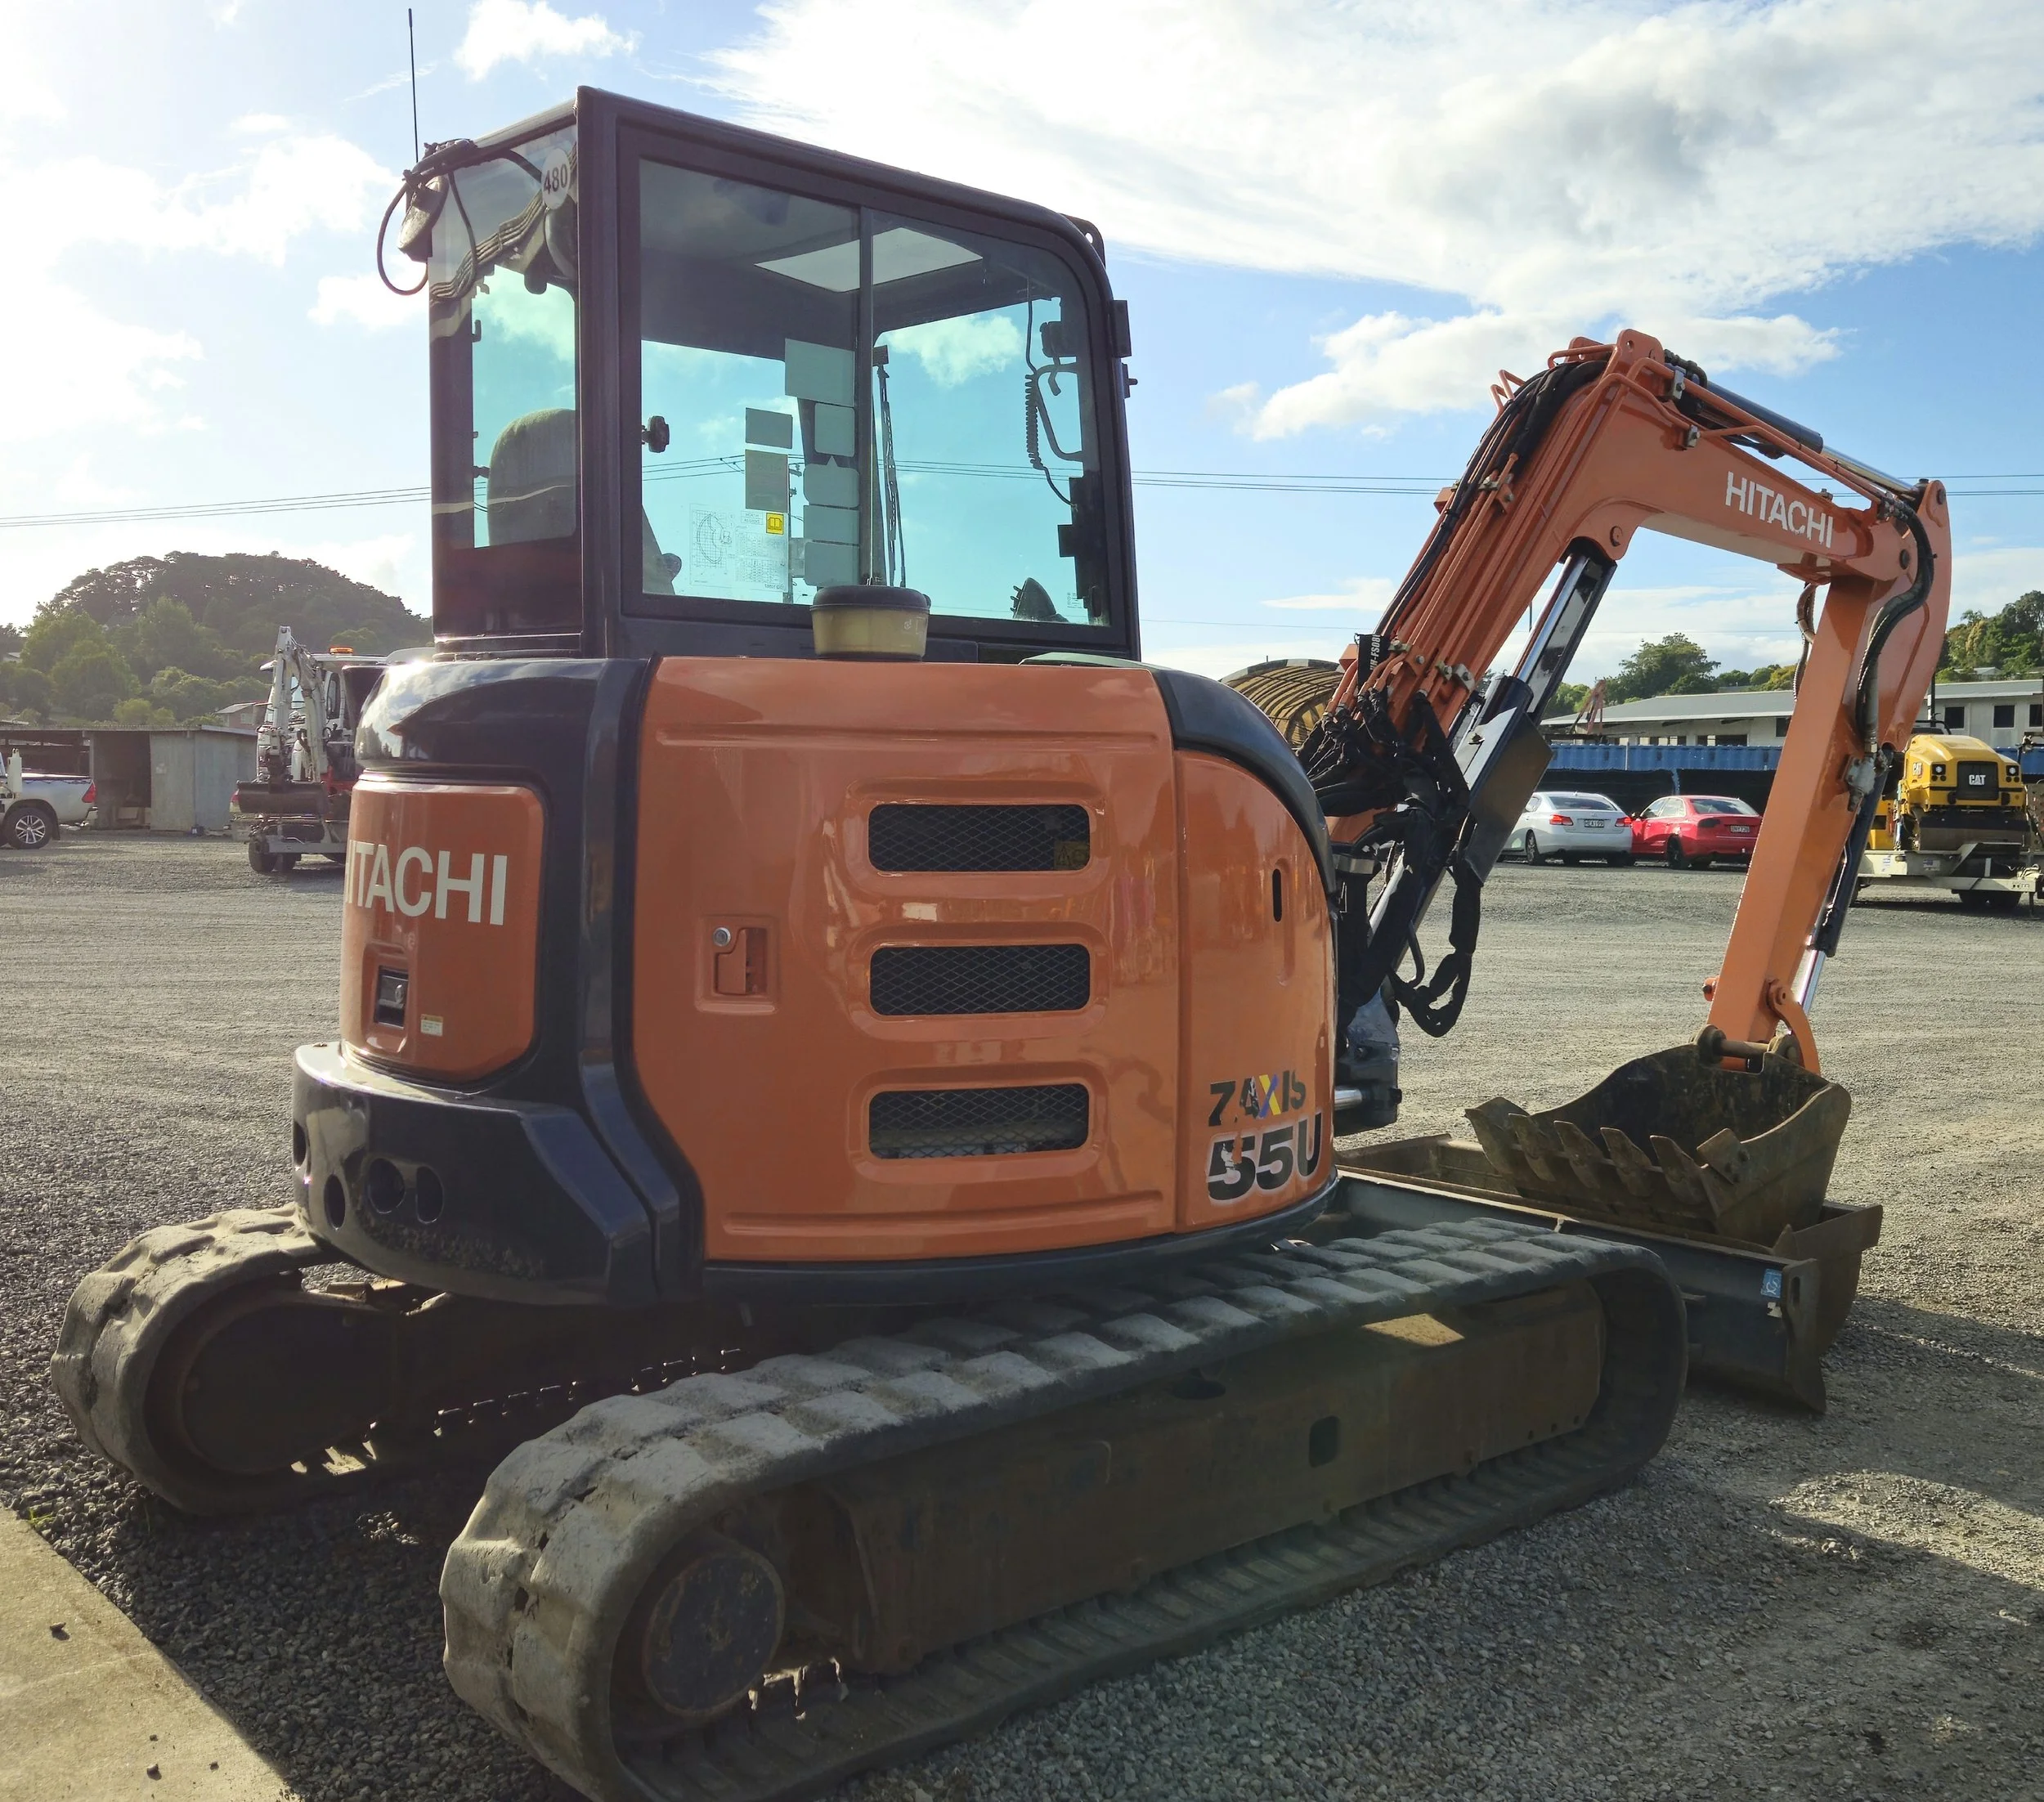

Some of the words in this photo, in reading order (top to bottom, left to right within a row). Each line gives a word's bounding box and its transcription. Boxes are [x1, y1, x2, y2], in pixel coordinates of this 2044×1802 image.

[544, 164, 567, 195] 480
[1725, 471, 1833, 549] HITACHI
[1969, 774, 1986, 785] CAT
[1208, 1112, 1322, 1201] 55U
